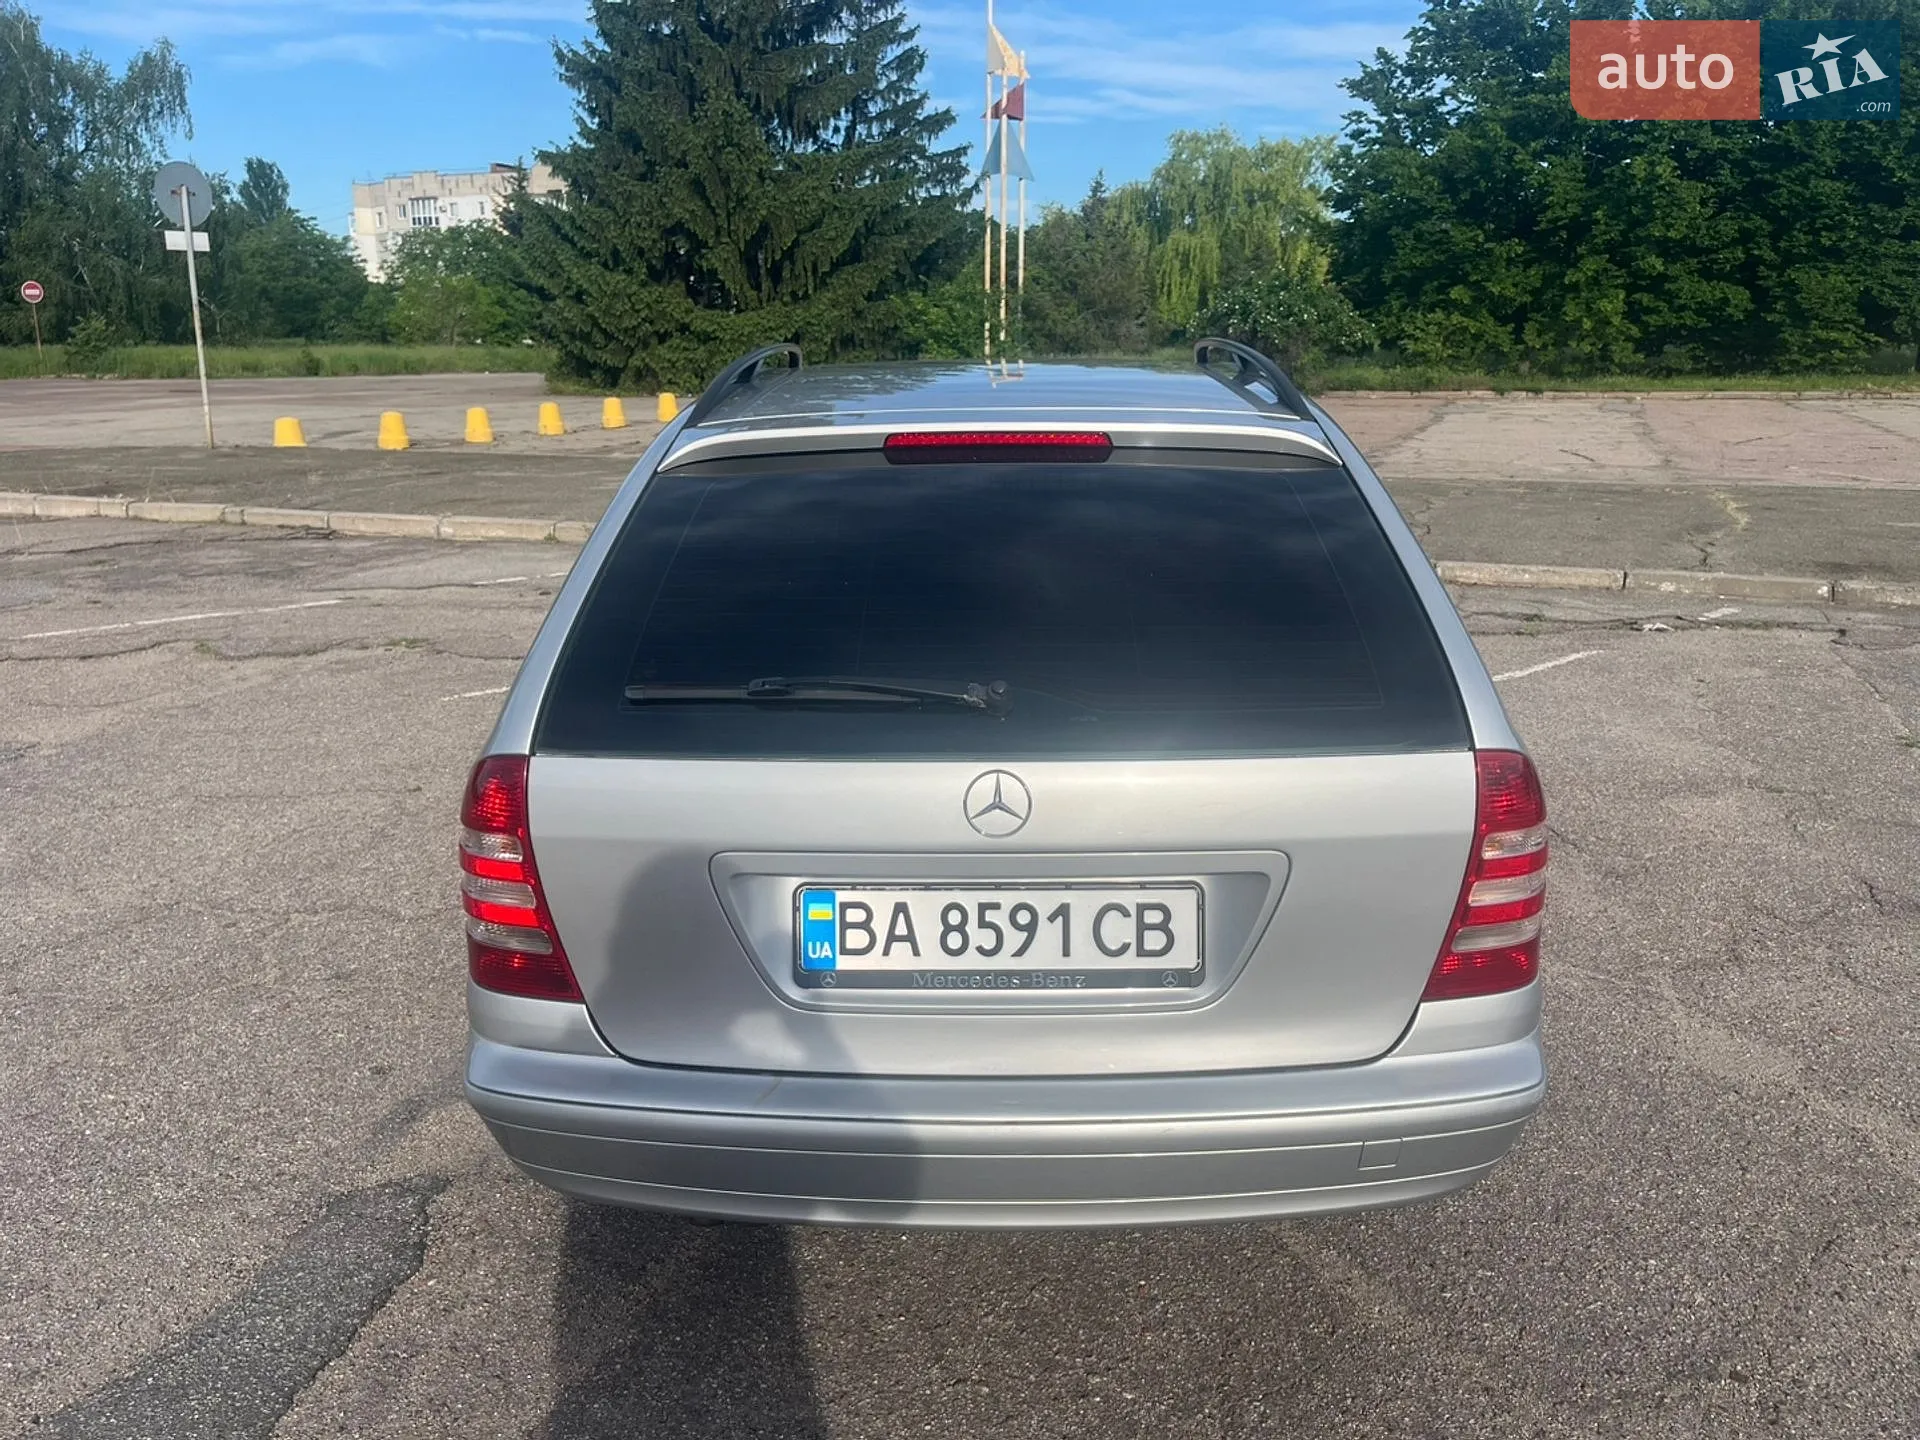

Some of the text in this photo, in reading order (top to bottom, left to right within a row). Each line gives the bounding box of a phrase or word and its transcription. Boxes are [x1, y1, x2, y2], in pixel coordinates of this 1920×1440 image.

[838, 901, 1175, 957] BA 8591 CB
[808, 941, 833, 958] UA
[911, 972, 1087, 989] Mercedes-Benz
